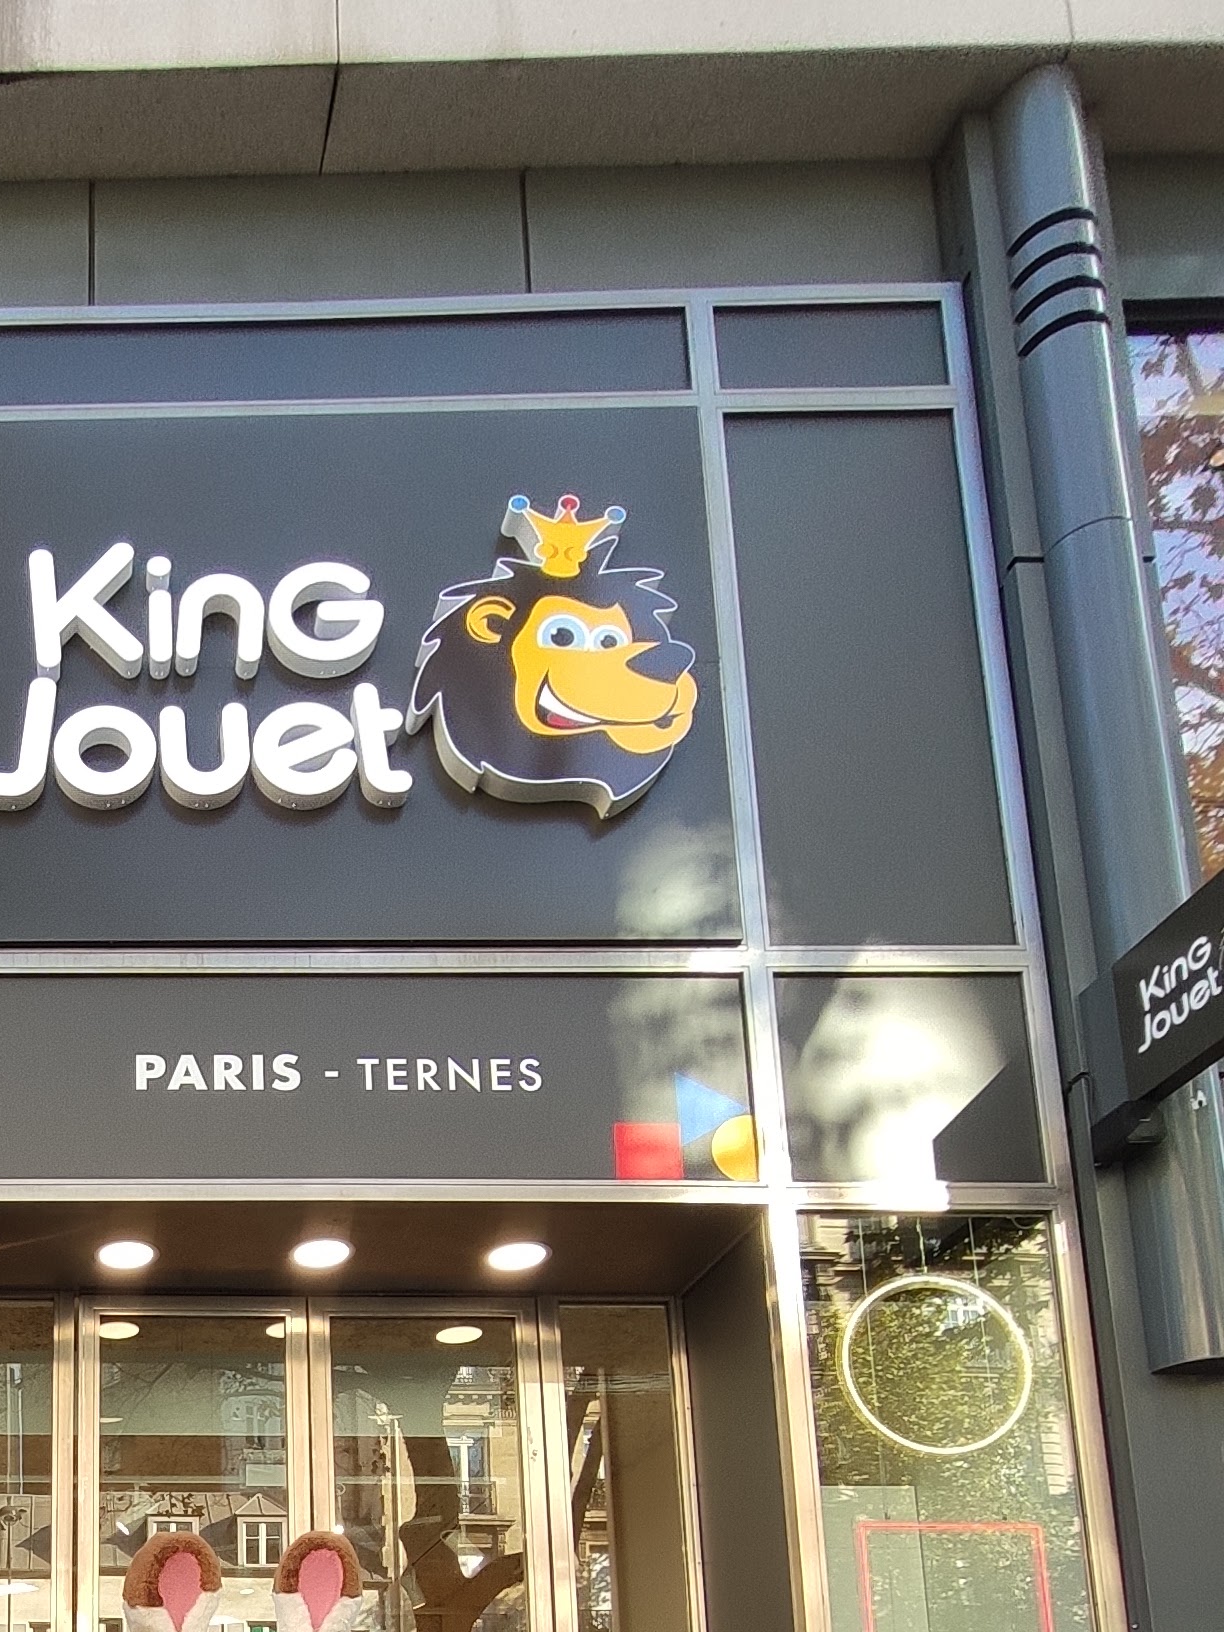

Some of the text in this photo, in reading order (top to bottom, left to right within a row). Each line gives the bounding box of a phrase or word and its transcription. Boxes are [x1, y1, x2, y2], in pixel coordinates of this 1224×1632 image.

[1137, 966, 1222, 1054] Jouet
[134, 1053, 302, 1092] PARIS
[356, 1056, 544, 1093] TERNES
